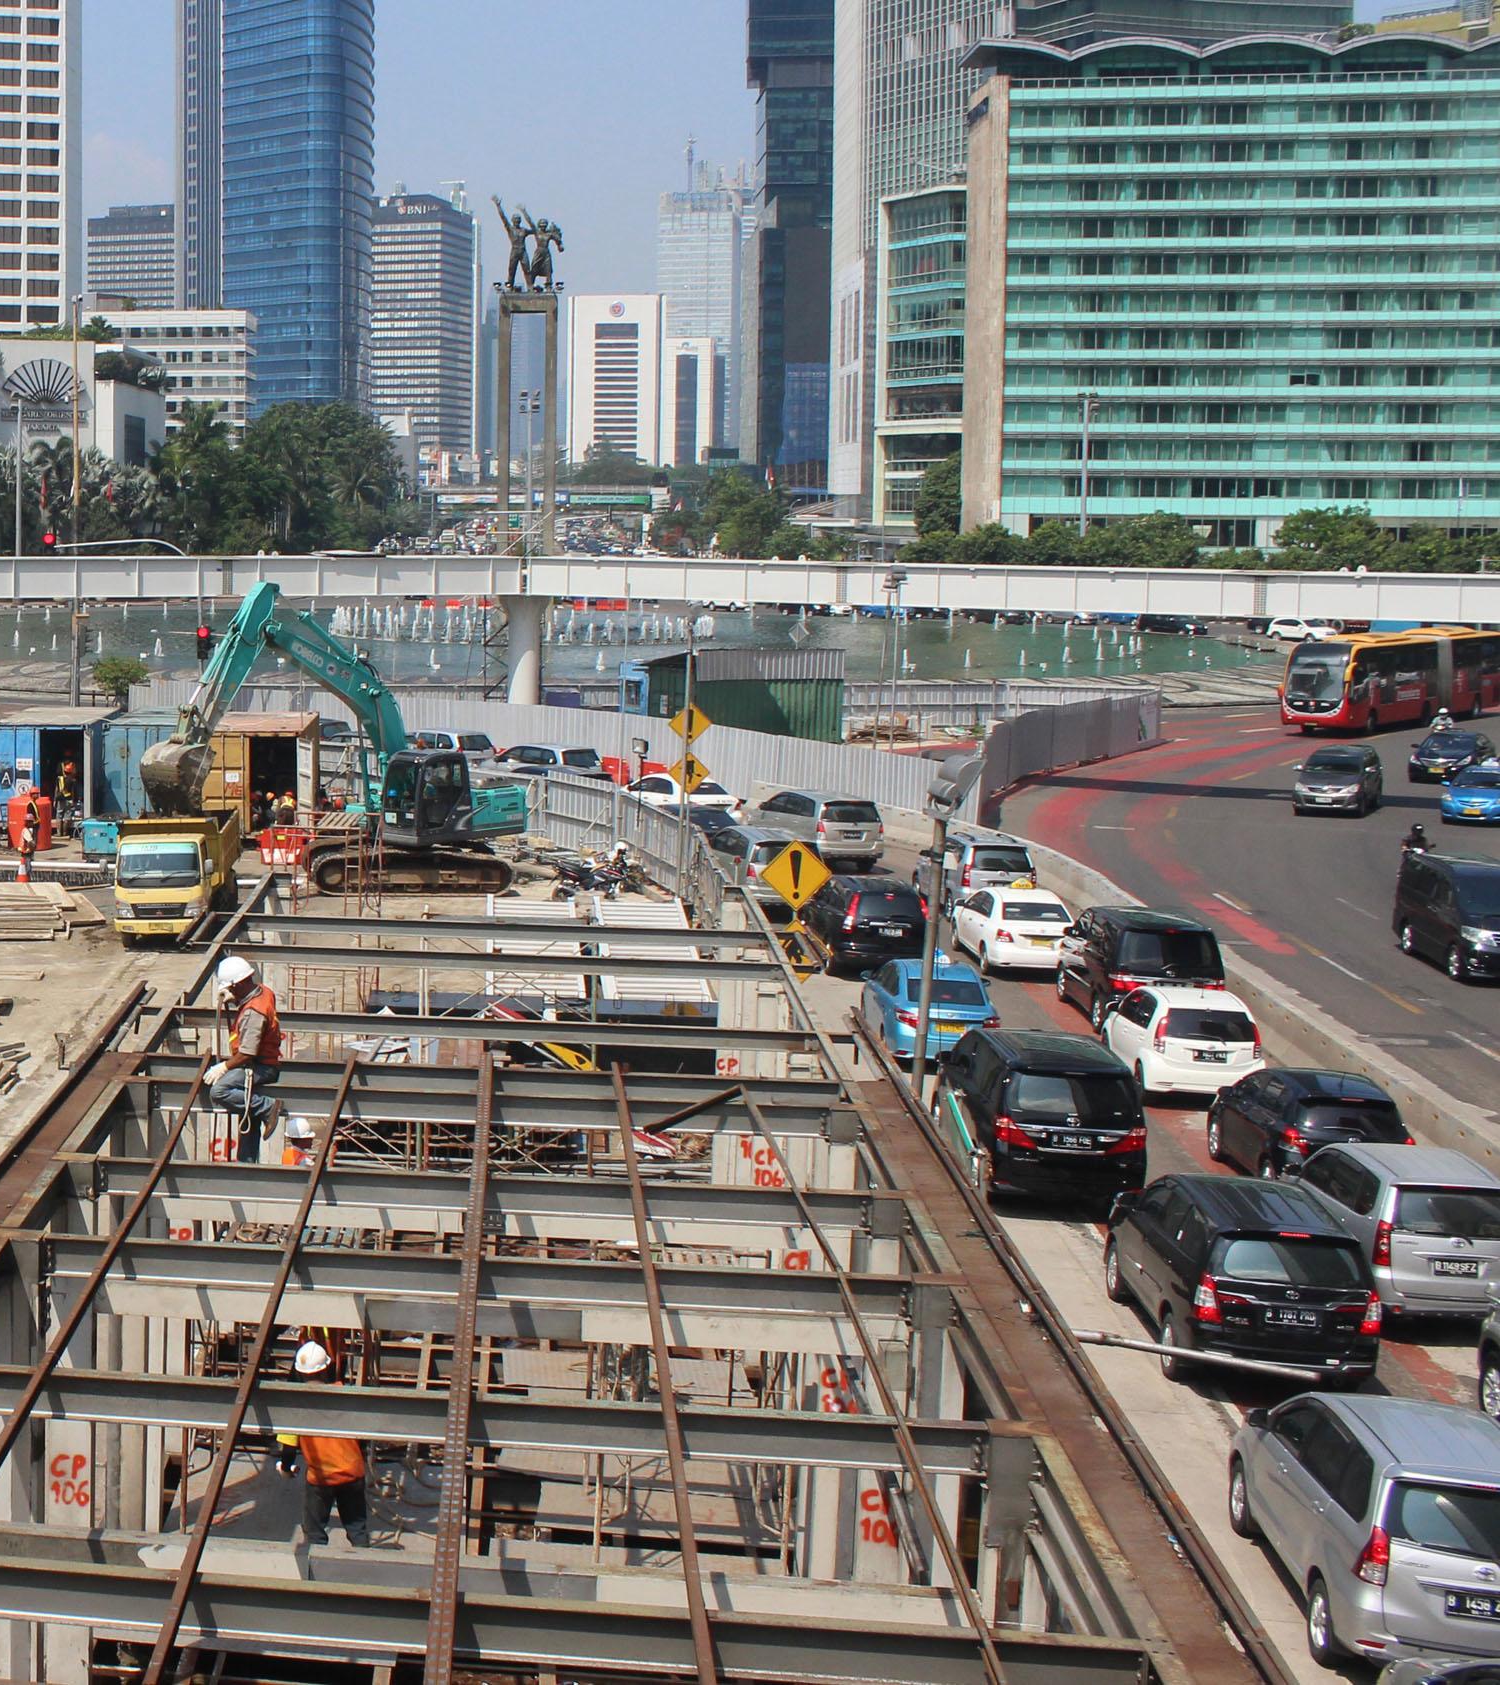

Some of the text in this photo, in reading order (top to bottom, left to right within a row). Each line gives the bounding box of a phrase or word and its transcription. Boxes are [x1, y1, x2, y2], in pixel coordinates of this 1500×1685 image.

[717, 1058, 738, 1072] CP
[50, 1453, 87, 1480] CP
[50, 1480, 90, 1508] 106
[1448, 1595, 1456, 1606] B
